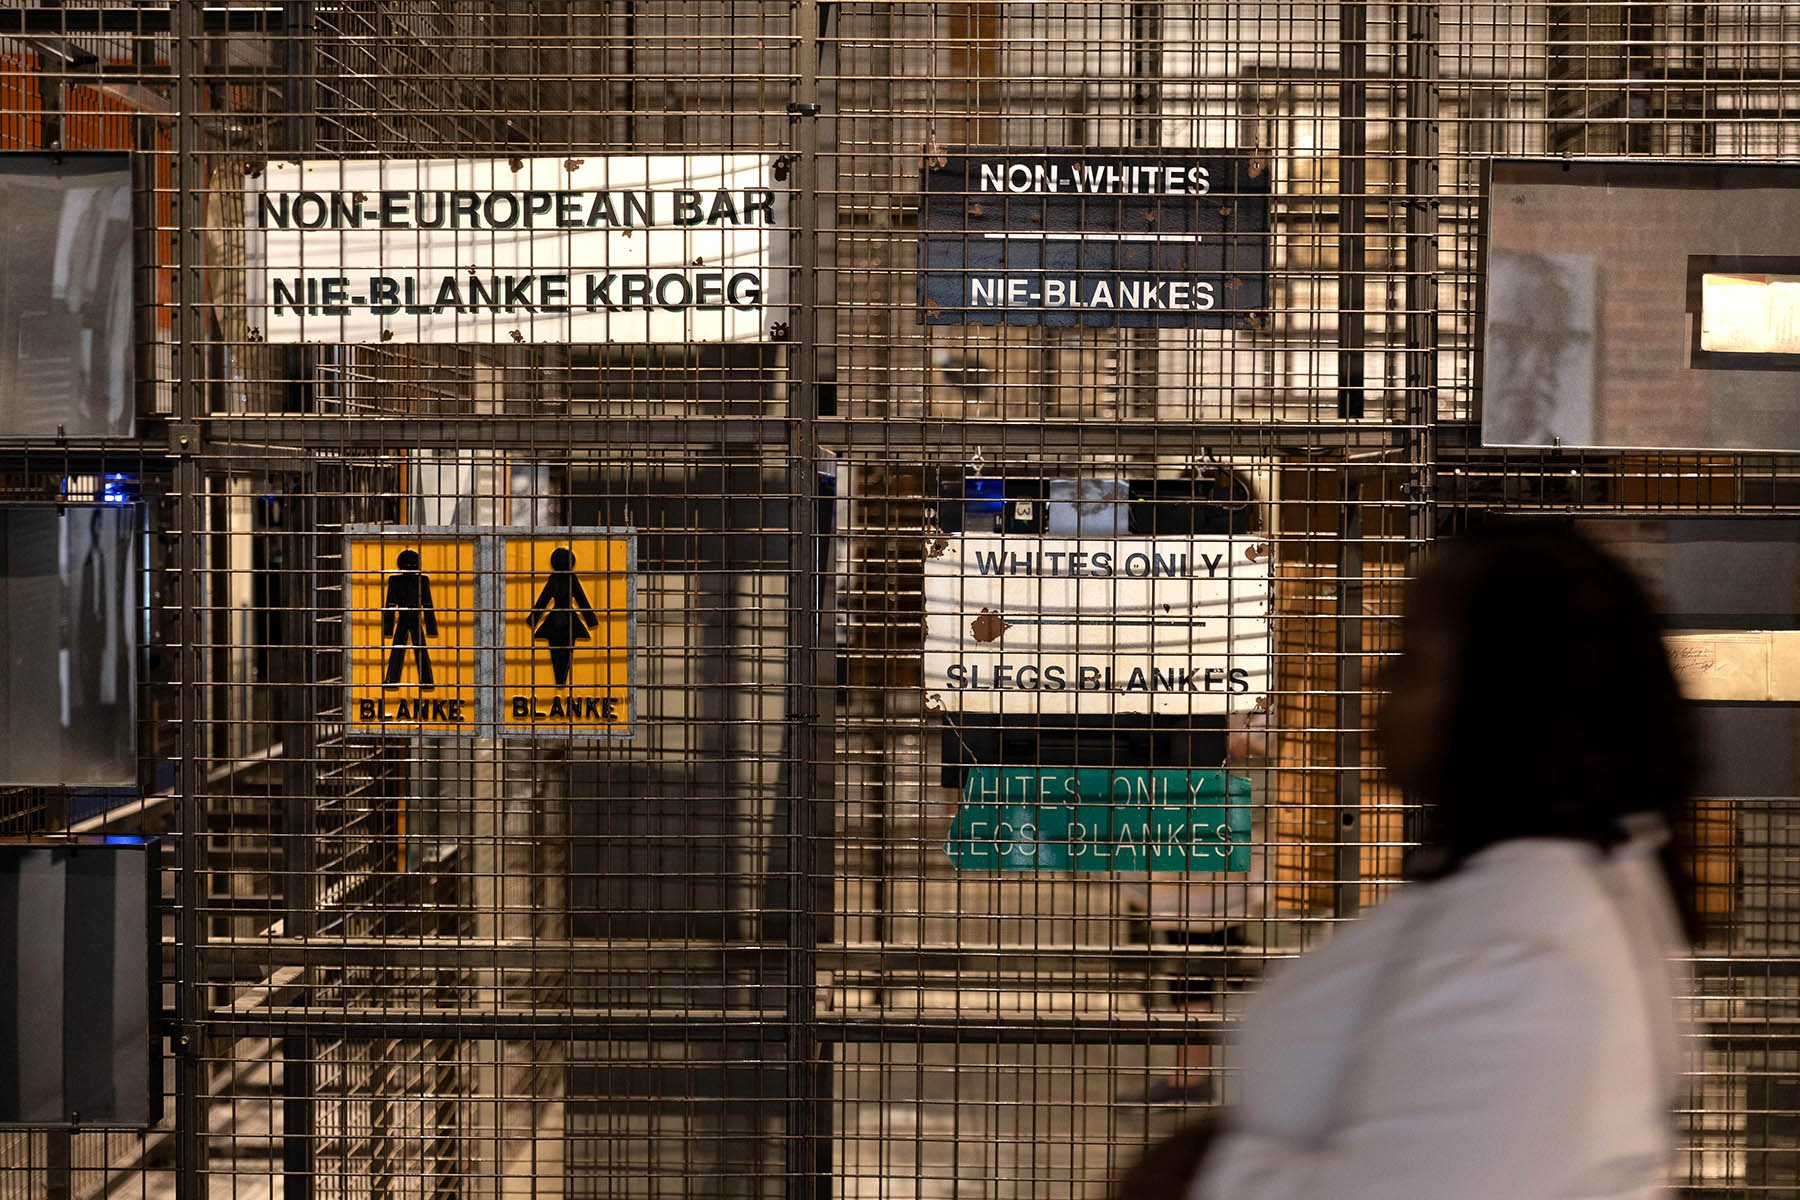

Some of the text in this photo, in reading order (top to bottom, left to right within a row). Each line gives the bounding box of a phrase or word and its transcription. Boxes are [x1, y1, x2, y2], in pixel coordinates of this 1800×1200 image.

[980, 164, 1210, 195] NON-WHITES
[258, 187, 776, 229] NON-EUROPEAN BAR
[273, 273, 763, 316] NIE-BLANKE KROEG
[971, 278, 1214, 311] NIE-BLANKES
[975, 551, 1223, 578] WHITES ONLY
[946, 664, 1249, 694] SLEGS BLANKES
[359, 698, 465, 721] BLANKE
[512, 696, 618, 719] BLANKE
[1113, 776, 1205, 810] ONLY
[1067, 822, 1234, 857] BLANKES
